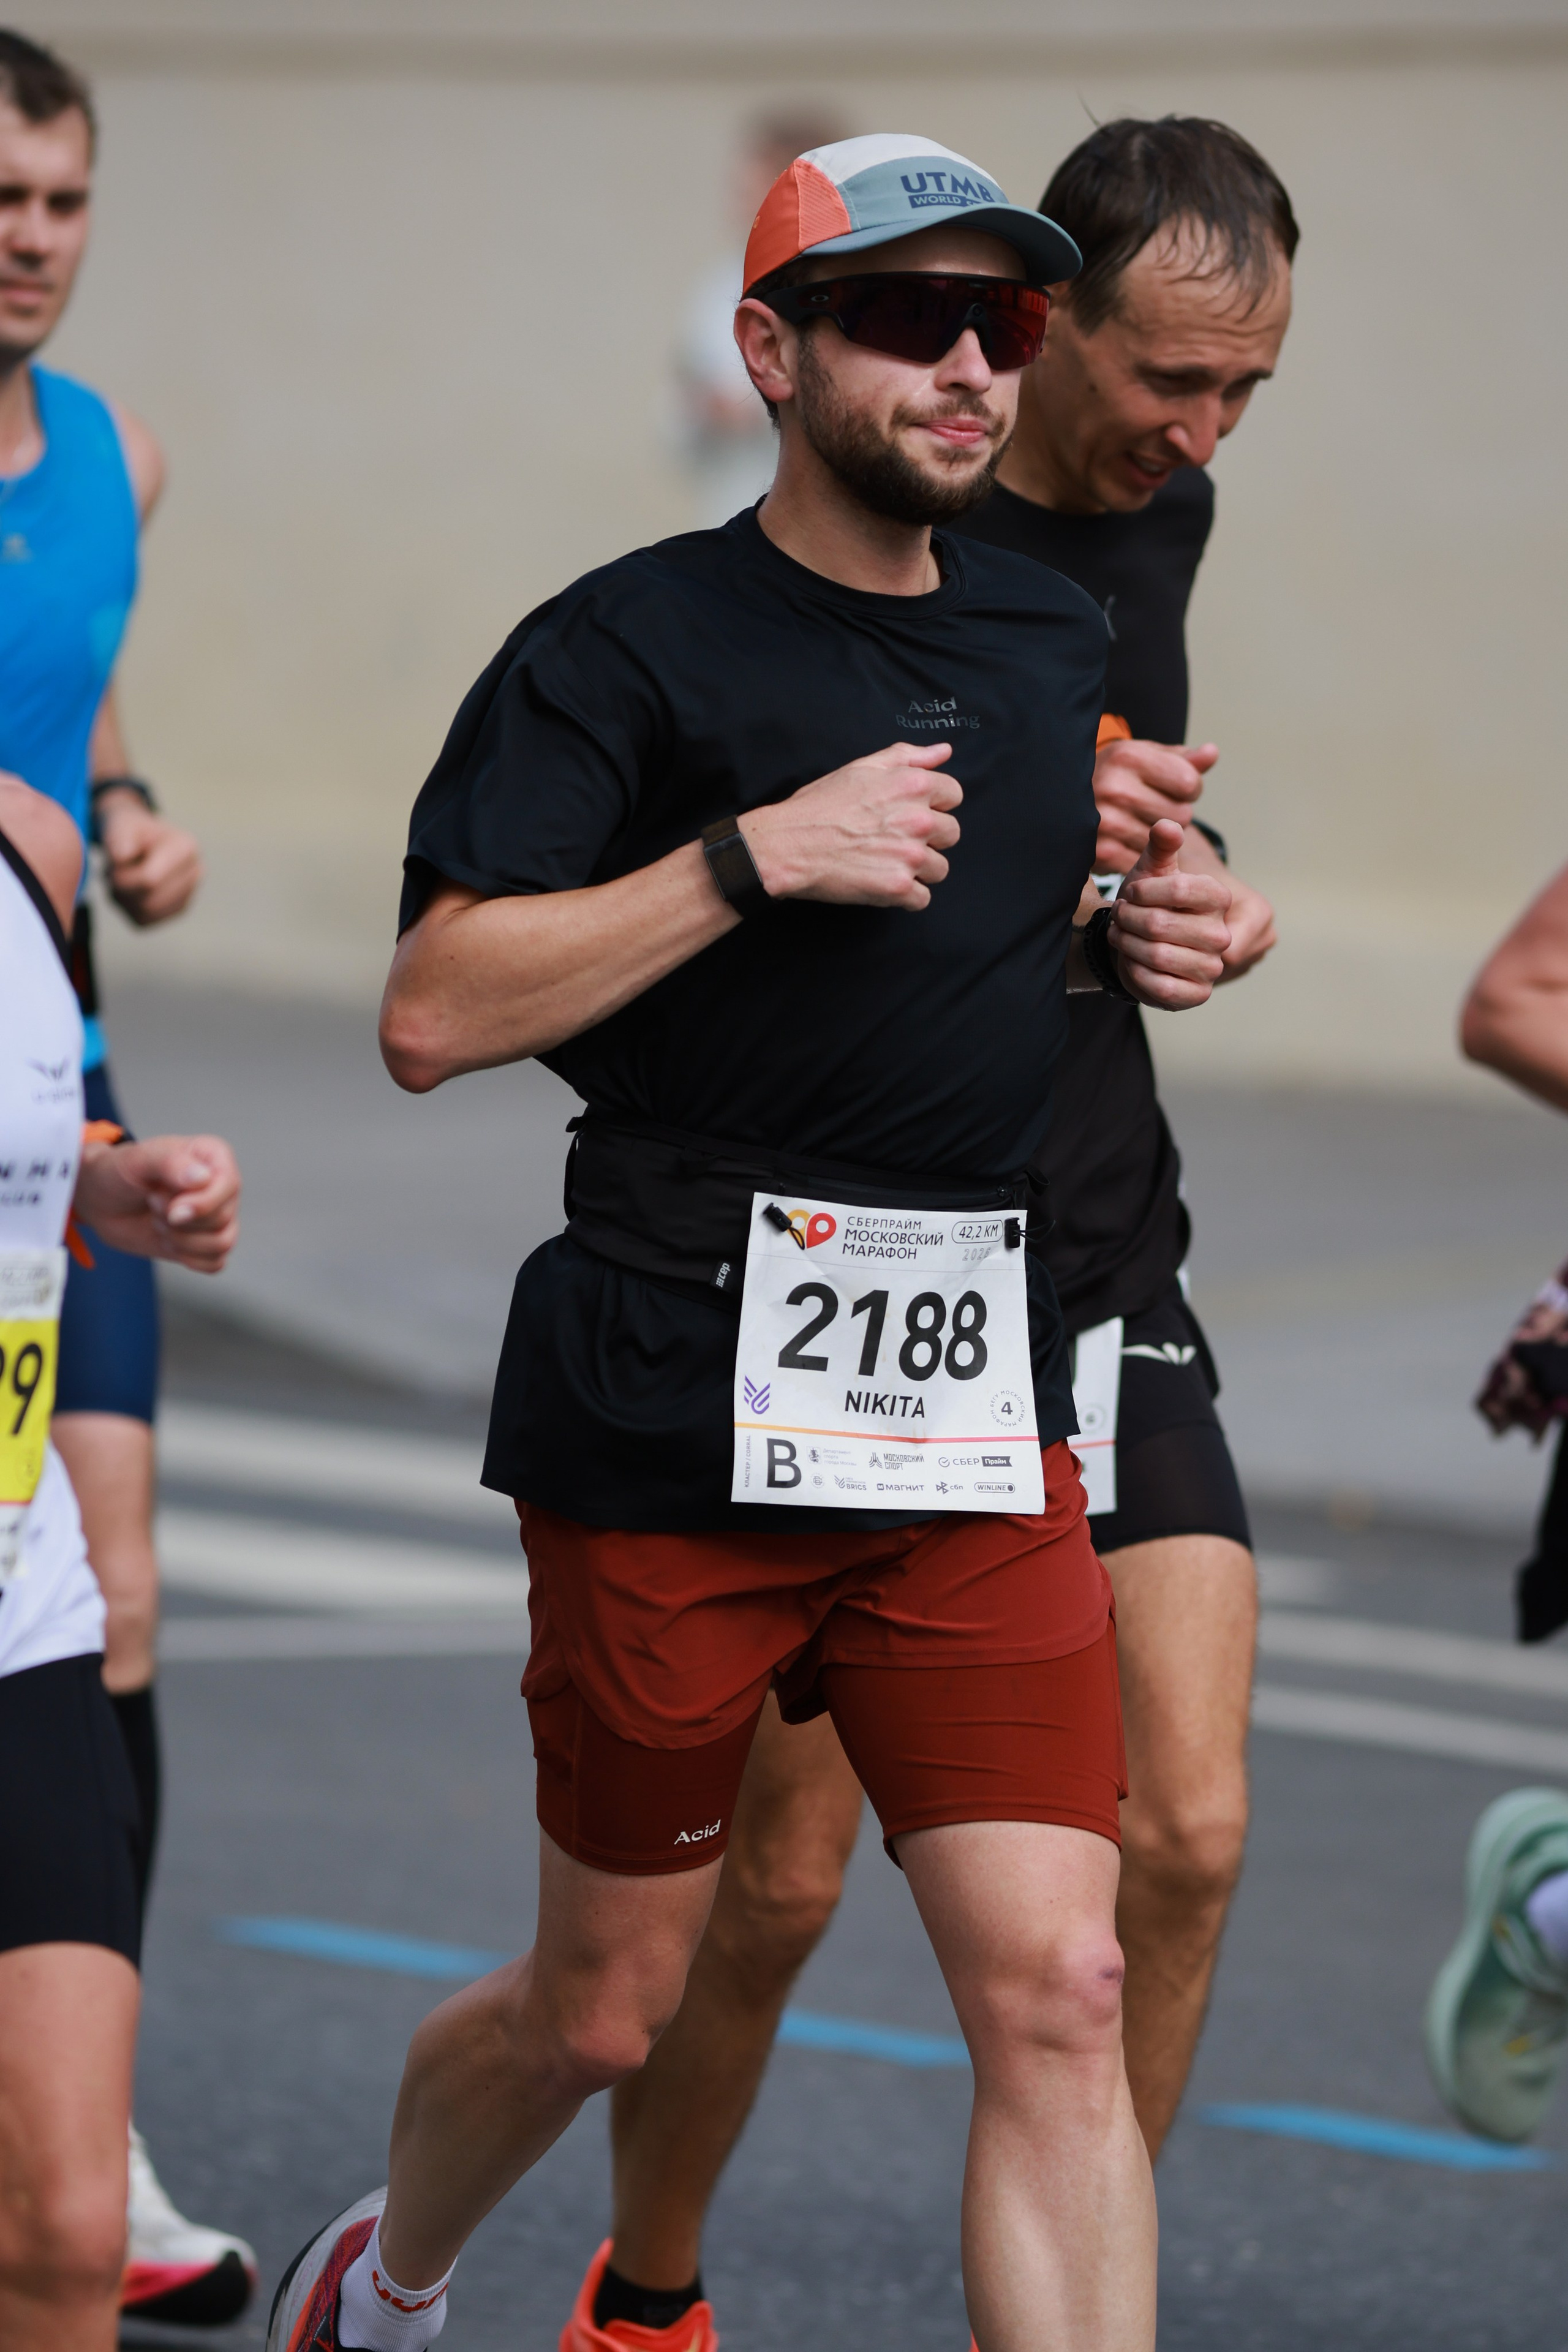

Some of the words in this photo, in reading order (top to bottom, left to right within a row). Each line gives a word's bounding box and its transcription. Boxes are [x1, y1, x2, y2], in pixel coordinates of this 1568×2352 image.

[900, 172, 995, 202] UTMB
[913, 195, 961, 205] WORLD
[908, 696, 957, 713] Acid
[895, 714, 980, 729] Running
[847, 1216, 922, 1230] СБЕРПРАЙМ
[845, 1229, 944, 1246] МОСКОВСКИЙ
[959, 1226, 982, 1240] 42,2
[842, 1243, 918, 1259] МАРАФОН
[777, 1281, 988, 1381] 2188
[844, 1390, 925, 1419] NIKITA
[1001, 1401, 1013, 1415] 4
[766, 1438, 802, 1488] B
[883, 1453, 924, 1463] МОСКОВСКИЙ
[884, 1461, 903, 1470] СПОРТ
[674, 1819, 721, 1845] Acid
